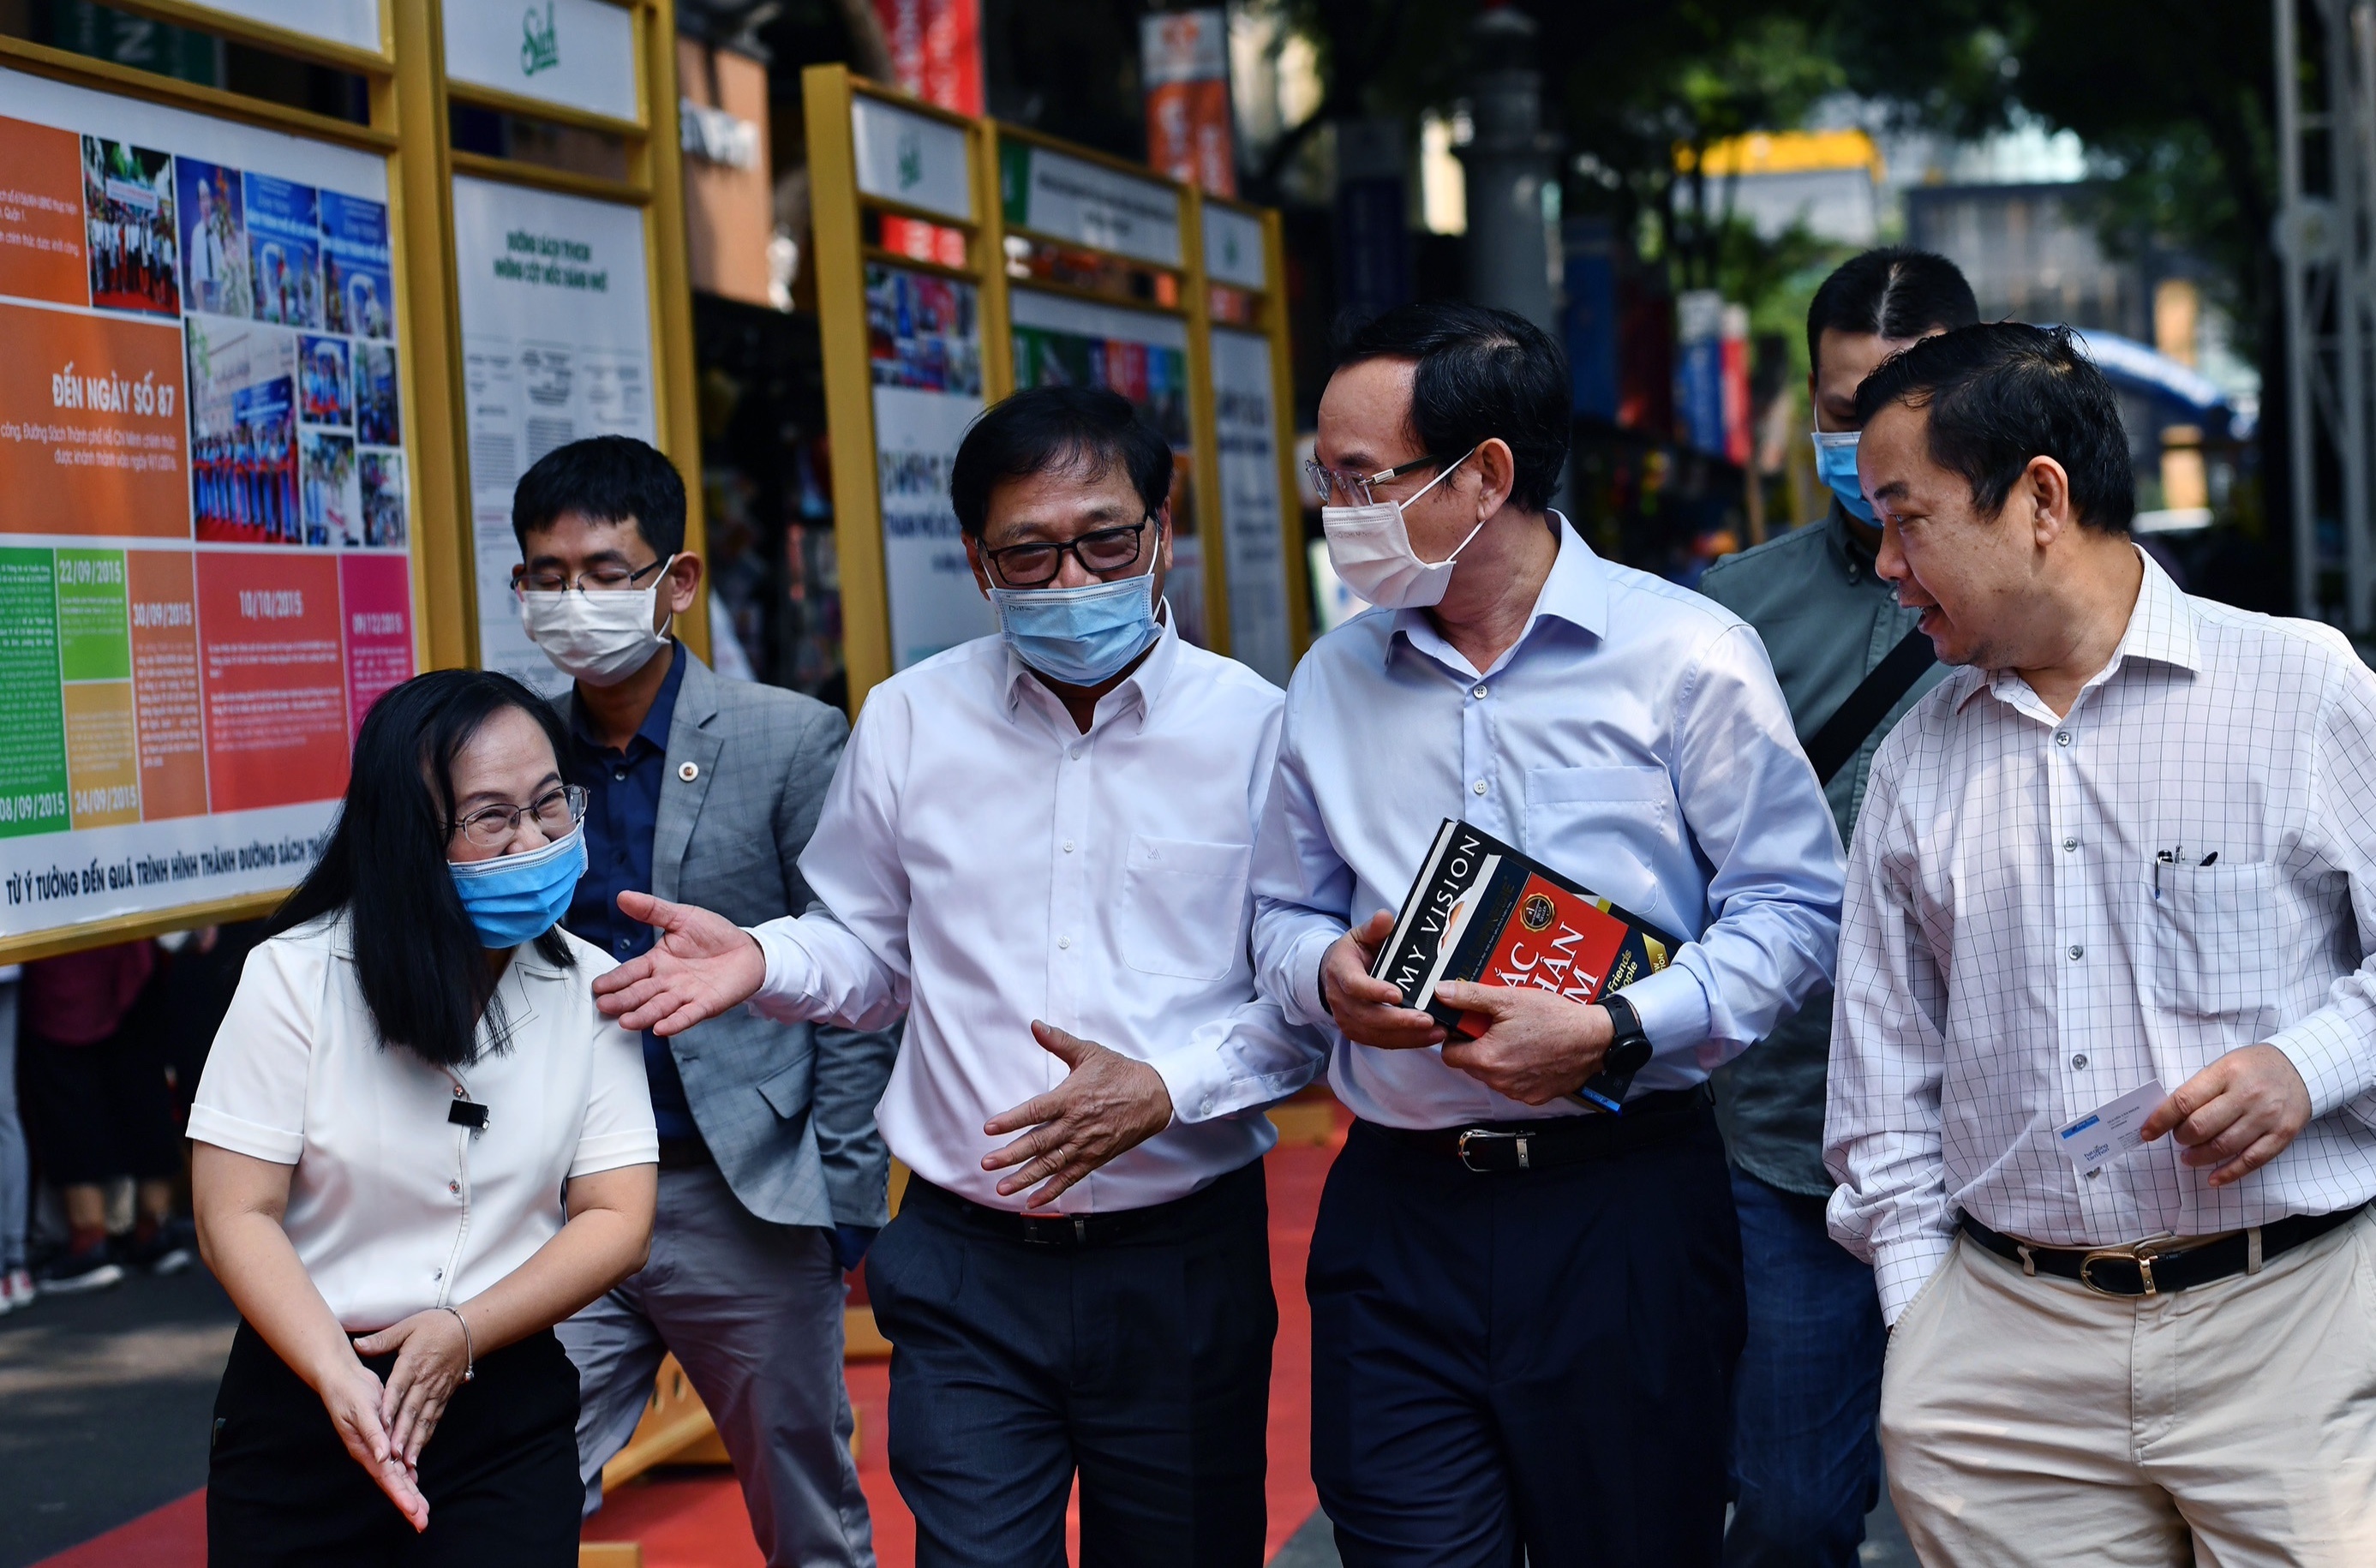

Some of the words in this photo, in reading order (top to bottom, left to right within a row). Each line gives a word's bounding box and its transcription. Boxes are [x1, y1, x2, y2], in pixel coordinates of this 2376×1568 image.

[52, 361, 84, 409] ĐẾN
[87, 369, 129, 413] NGÀY
[134, 370, 155, 416] SỐ
[158, 385, 175, 417] 87
[59, 560, 122, 586] 22/09/2015
[133, 602, 193, 628] 30/09/2015
[239, 589, 303, 621] 10/10/2015
[0, 792, 65, 823] 08/09/2015
[75, 784, 138, 815] 24/09/2015
[6, 871, 21, 905] TỪ
[25, 870, 33, 902] Ý
[36, 864, 79, 901] TƯỞNG
[81, 858, 105, 895] ĐẾN
[109, 857, 134, 890] QUÁ
[136, 853, 169, 886] TRÌNH
[171, 850, 198, 881] HÌNH
[200, 845, 236, 876] THÀNH
[238, 840, 276, 871] ĐƯỜNG
[278, 835, 305, 865] SÁCH
[1396, 944, 1427, 992] MY
[1421, 835, 1481, 933] VISION
[1494, 942, 1540, 987] ẮC
[1533, 921, 1584, 993] ÂN
[1607, 949, 1632, 993] Friends
[1620, 961, 1638, 989] ople
